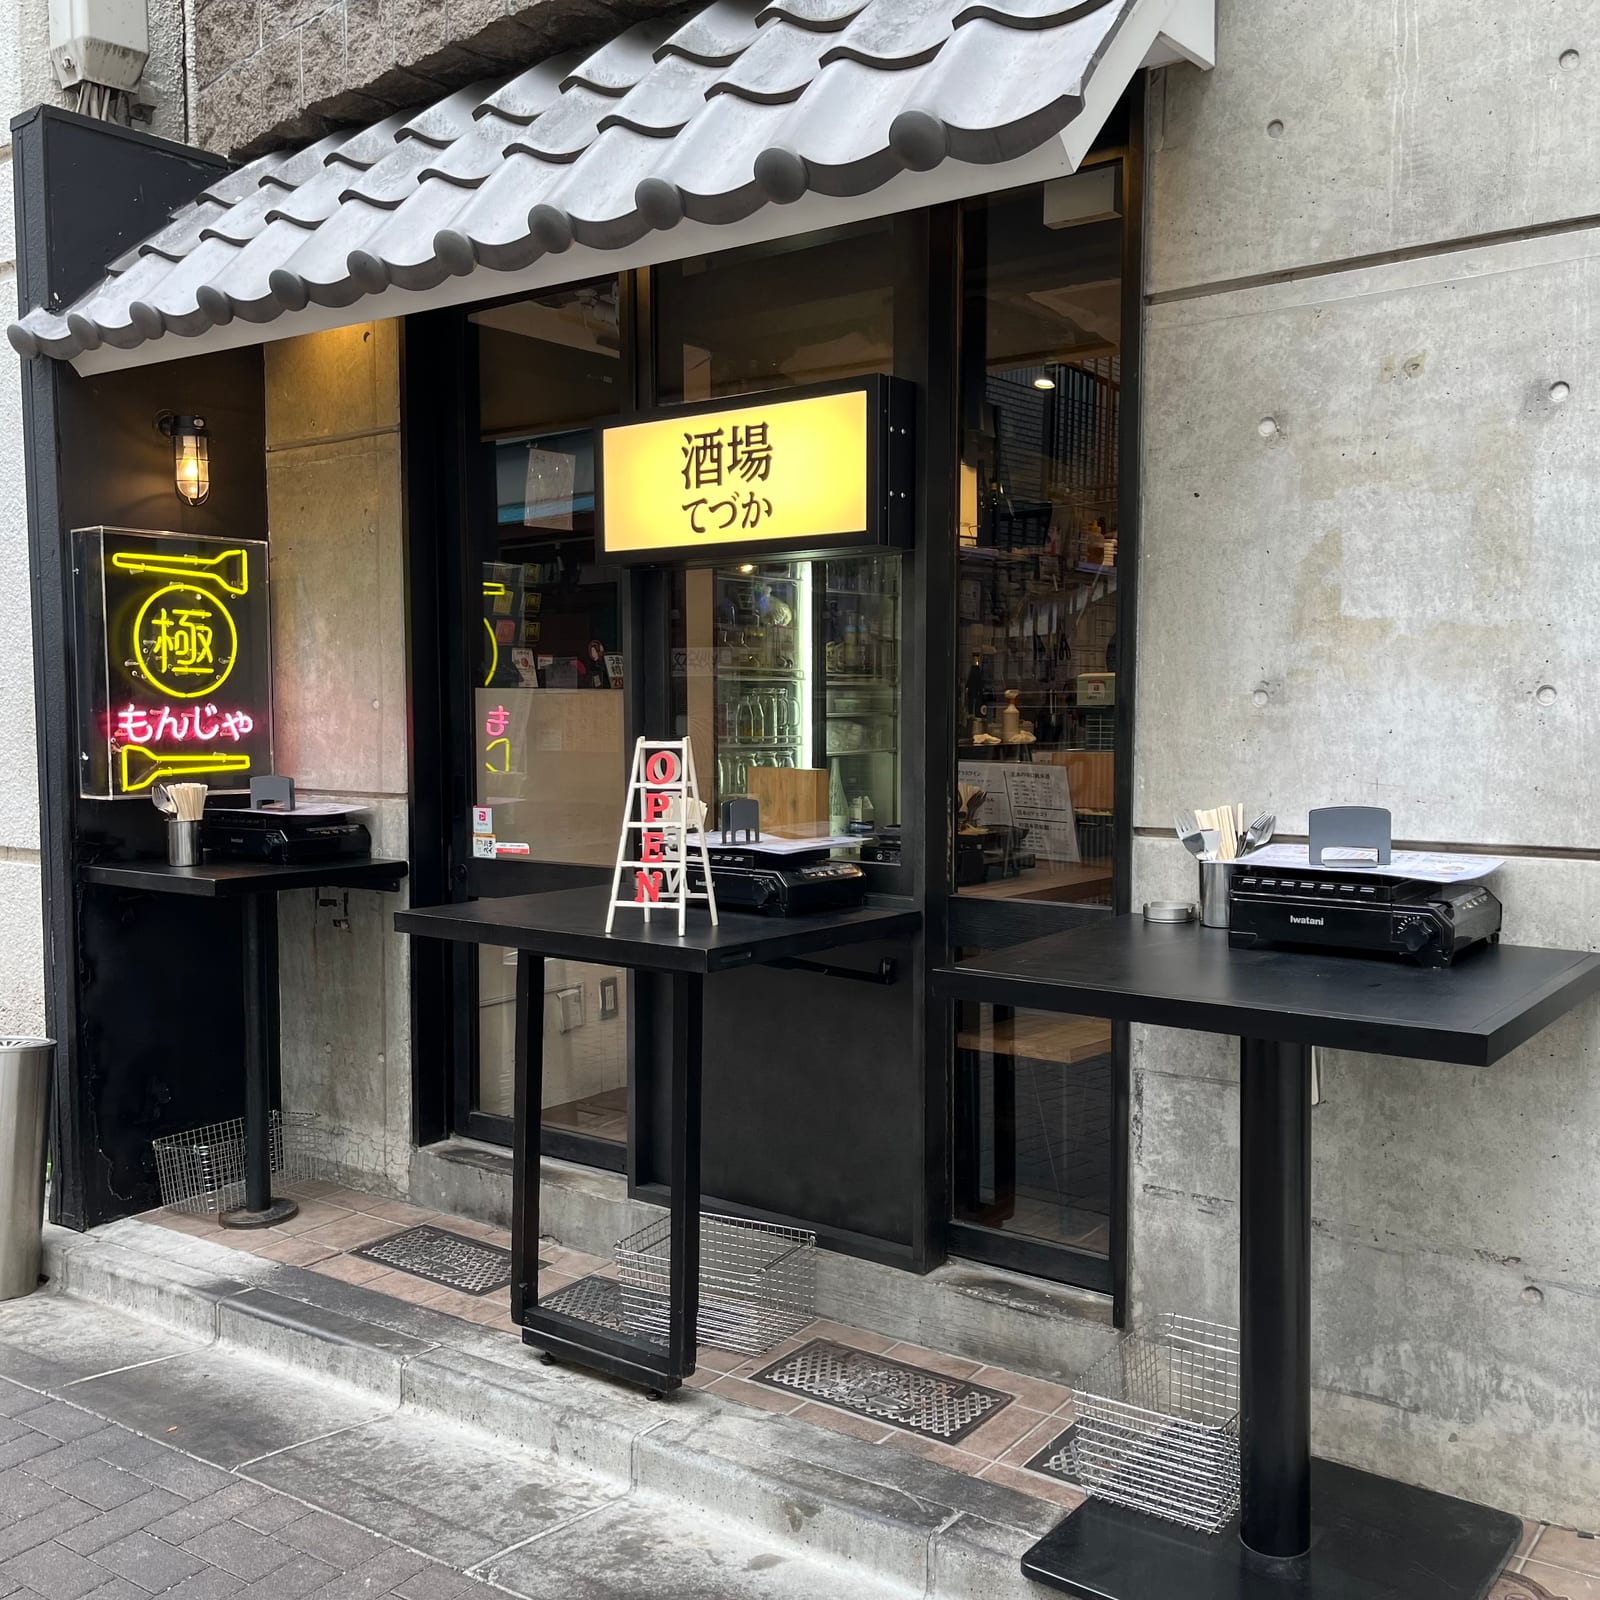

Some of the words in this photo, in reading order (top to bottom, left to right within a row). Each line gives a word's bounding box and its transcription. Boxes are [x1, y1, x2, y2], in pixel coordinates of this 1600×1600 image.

[681, 421, 773, 489] 酒場
[682, 491, 773, 533] てづか
[152, 608, 214, 673] 極
[118, 704, 253, 742] もんじゃ
[635, 752, 675, 903] OPEN
